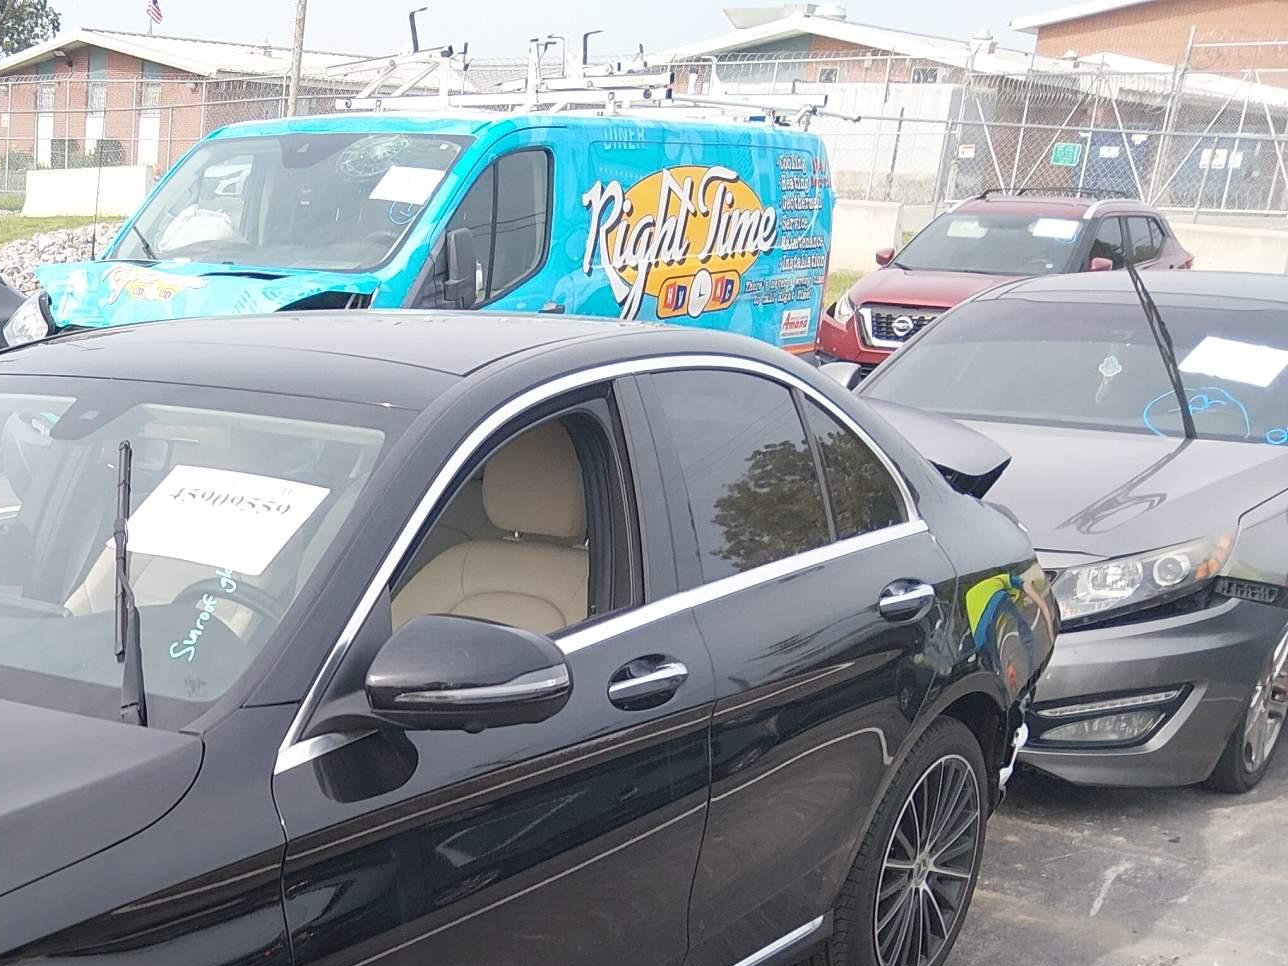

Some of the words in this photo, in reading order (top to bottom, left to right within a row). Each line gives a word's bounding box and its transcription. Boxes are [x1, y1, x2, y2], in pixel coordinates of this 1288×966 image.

[603, 127, 645, 149] DINER
[780, 154, 807, 174] Cooling
[781, 174, 809, 193] Heating
[782, 194, 823, 211] Geothermal
[782, 214, 808, 231] Service
[582, 168, 696, 320] Right
[697, 166, 778, 262] Time
[781, 235, 824, 250] Maintenance
[781, 253, 825, 271] Installation
[782, 311, 808, 331] Amana
